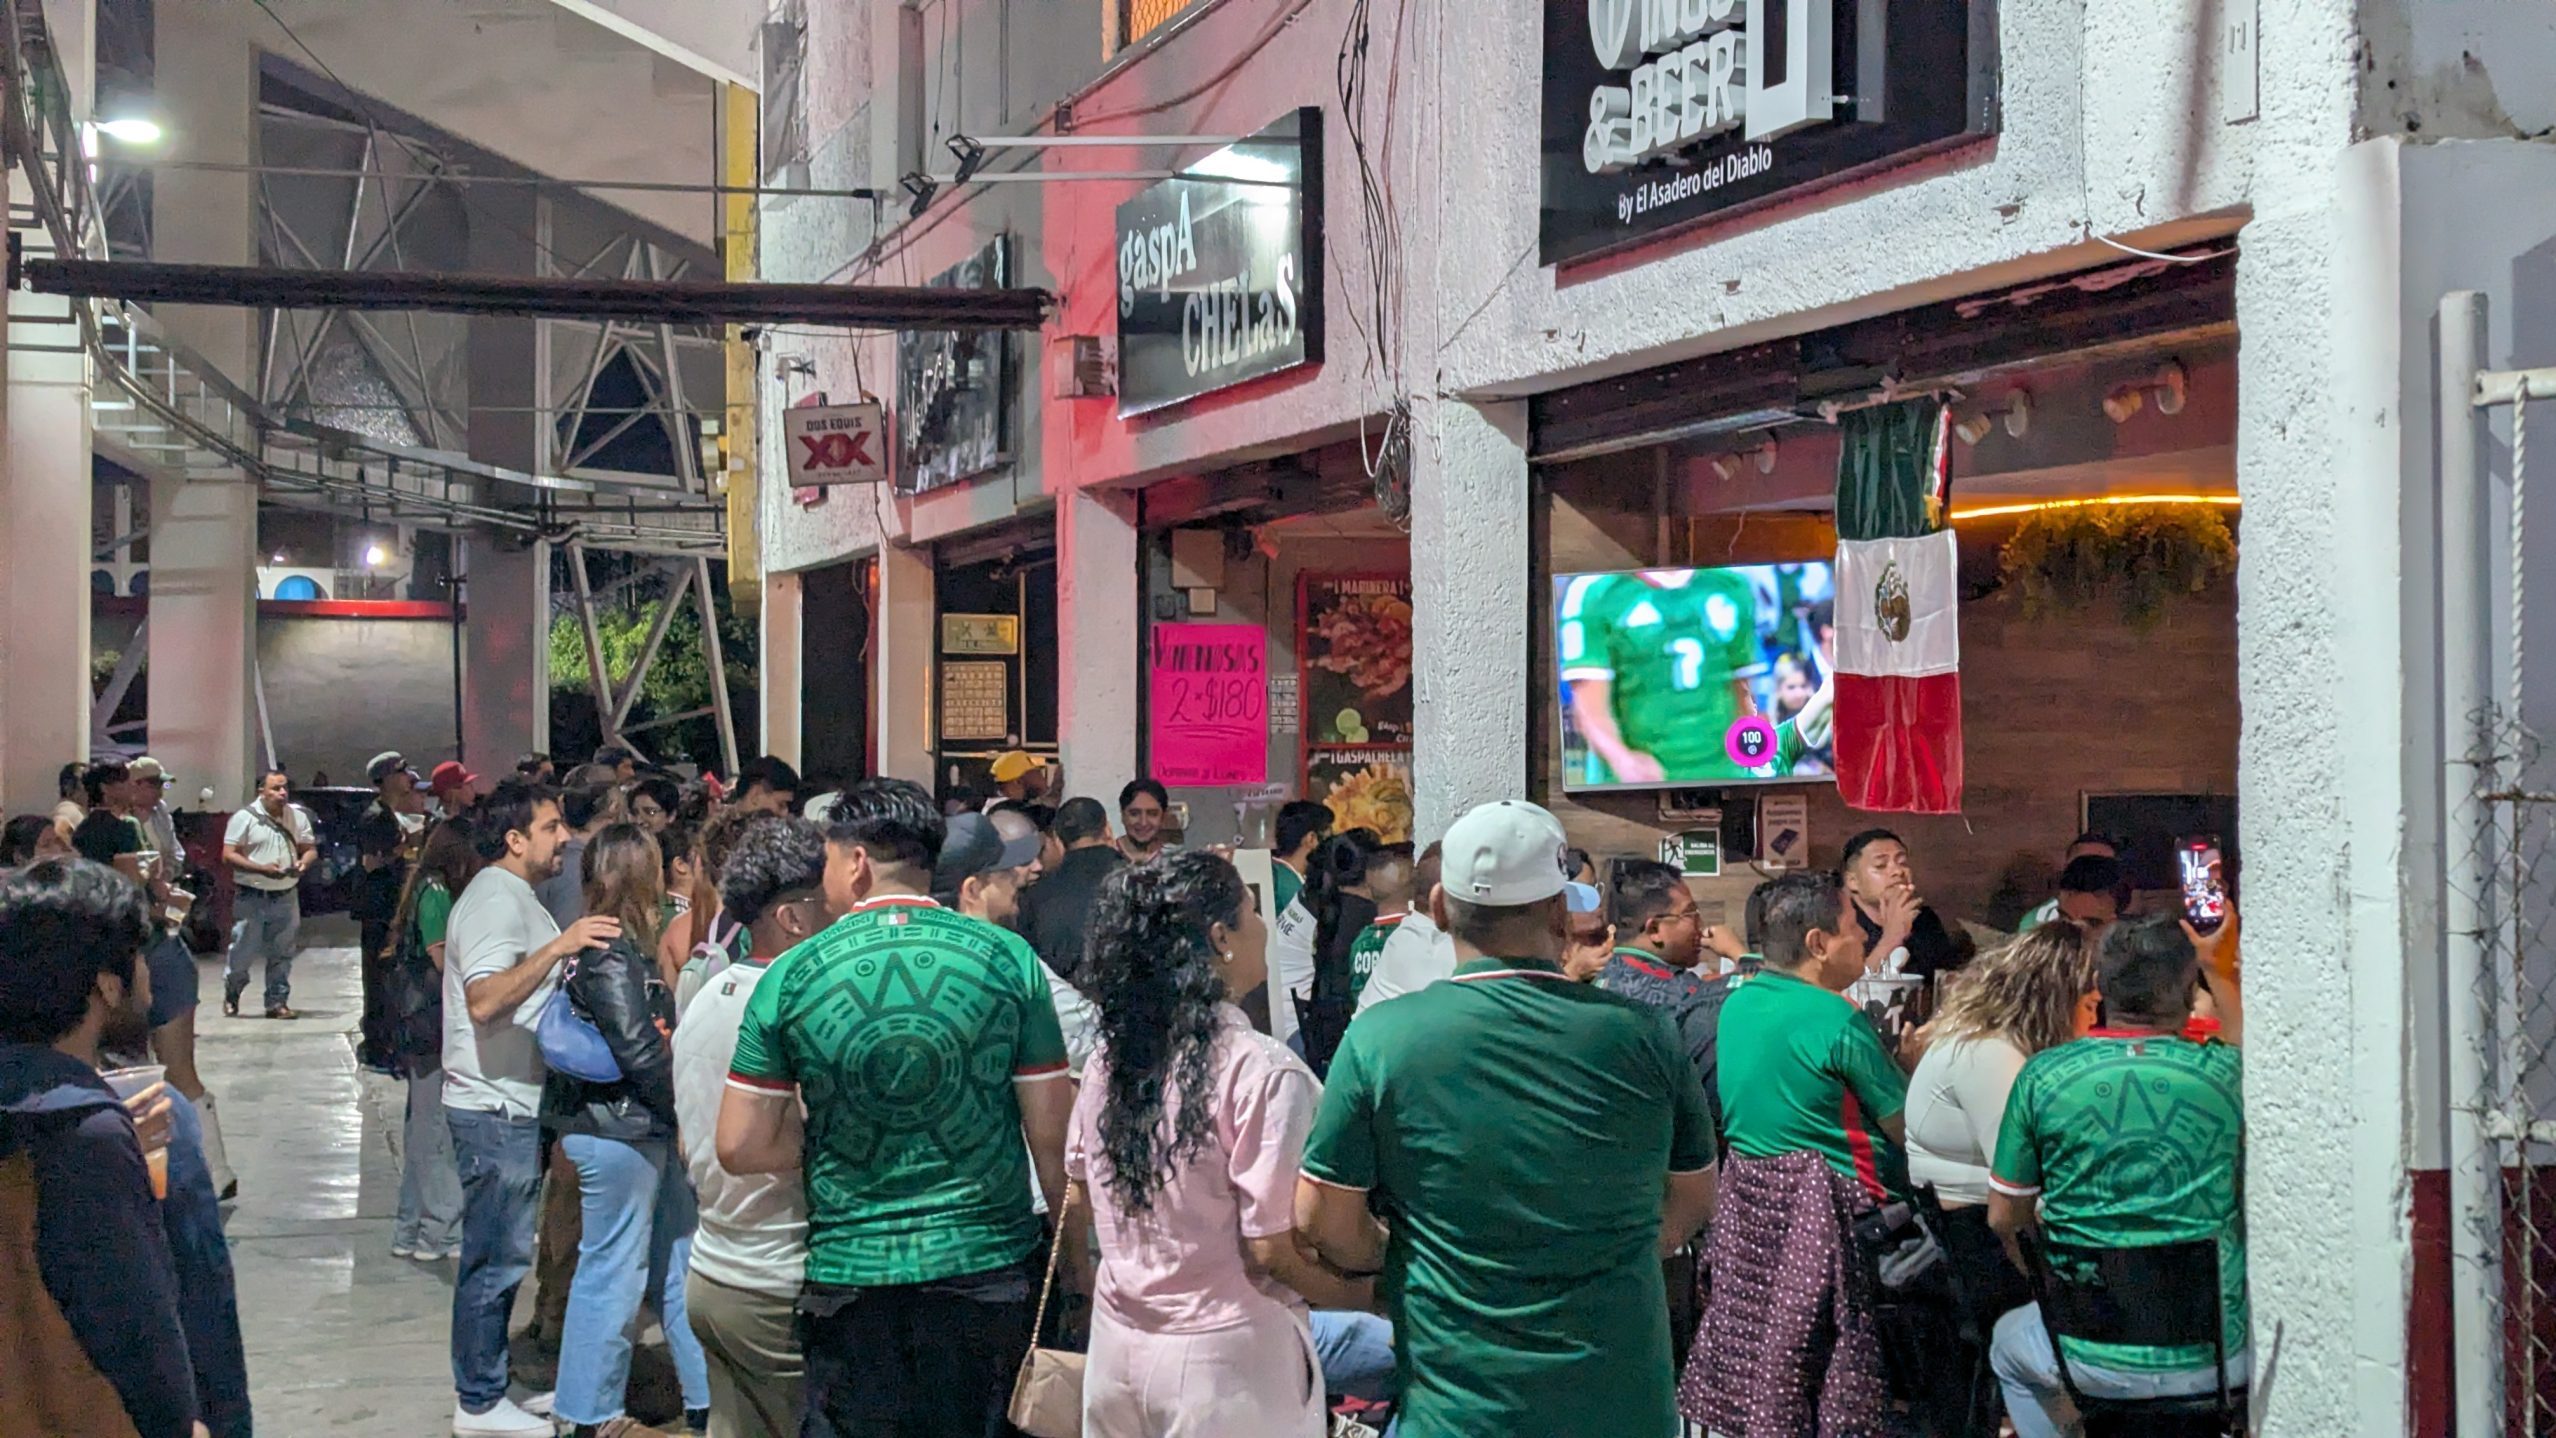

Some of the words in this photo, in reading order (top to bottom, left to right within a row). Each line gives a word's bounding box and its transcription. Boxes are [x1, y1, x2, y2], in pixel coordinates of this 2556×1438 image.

[1618, 193, 1633, 223] By
[1636, 184, 1647, 213] El
[1649, 172, 1700, 209] Asadero
[1703, 163, 1724, 190] del
[1727, 144, 1772, 183] Diablo
[806, 419, 828, 431] DOS
[830, 416, 862, 430] EQUIS
[798, 431, 876, 470] XX
[1742, 731, 1761, 744] 100
